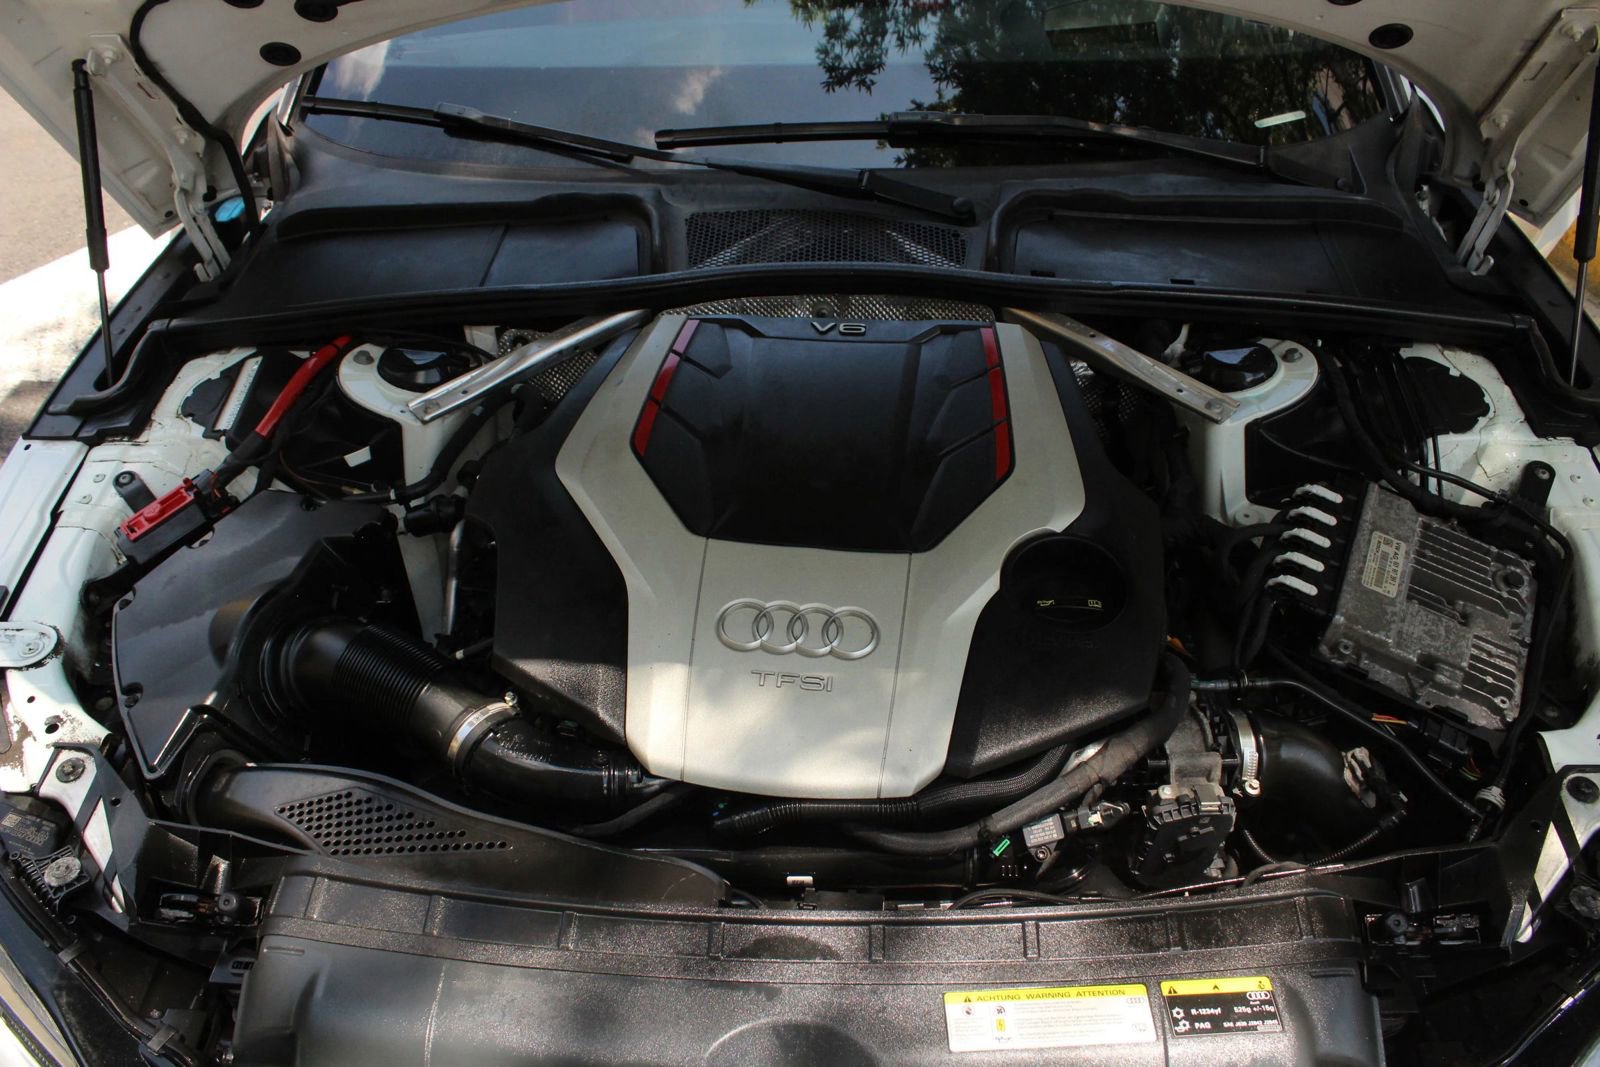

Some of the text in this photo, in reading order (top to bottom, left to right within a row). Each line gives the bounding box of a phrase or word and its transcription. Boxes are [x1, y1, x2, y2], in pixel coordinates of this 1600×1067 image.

[811, 321, 866, 335] V6
[751, 669, 834, 692] TFSI
[976, 989, 1126, 1002] ACHTUNG WARNING ATTENTION
[1190, 1007, 1221, 1016] R-1234yf
